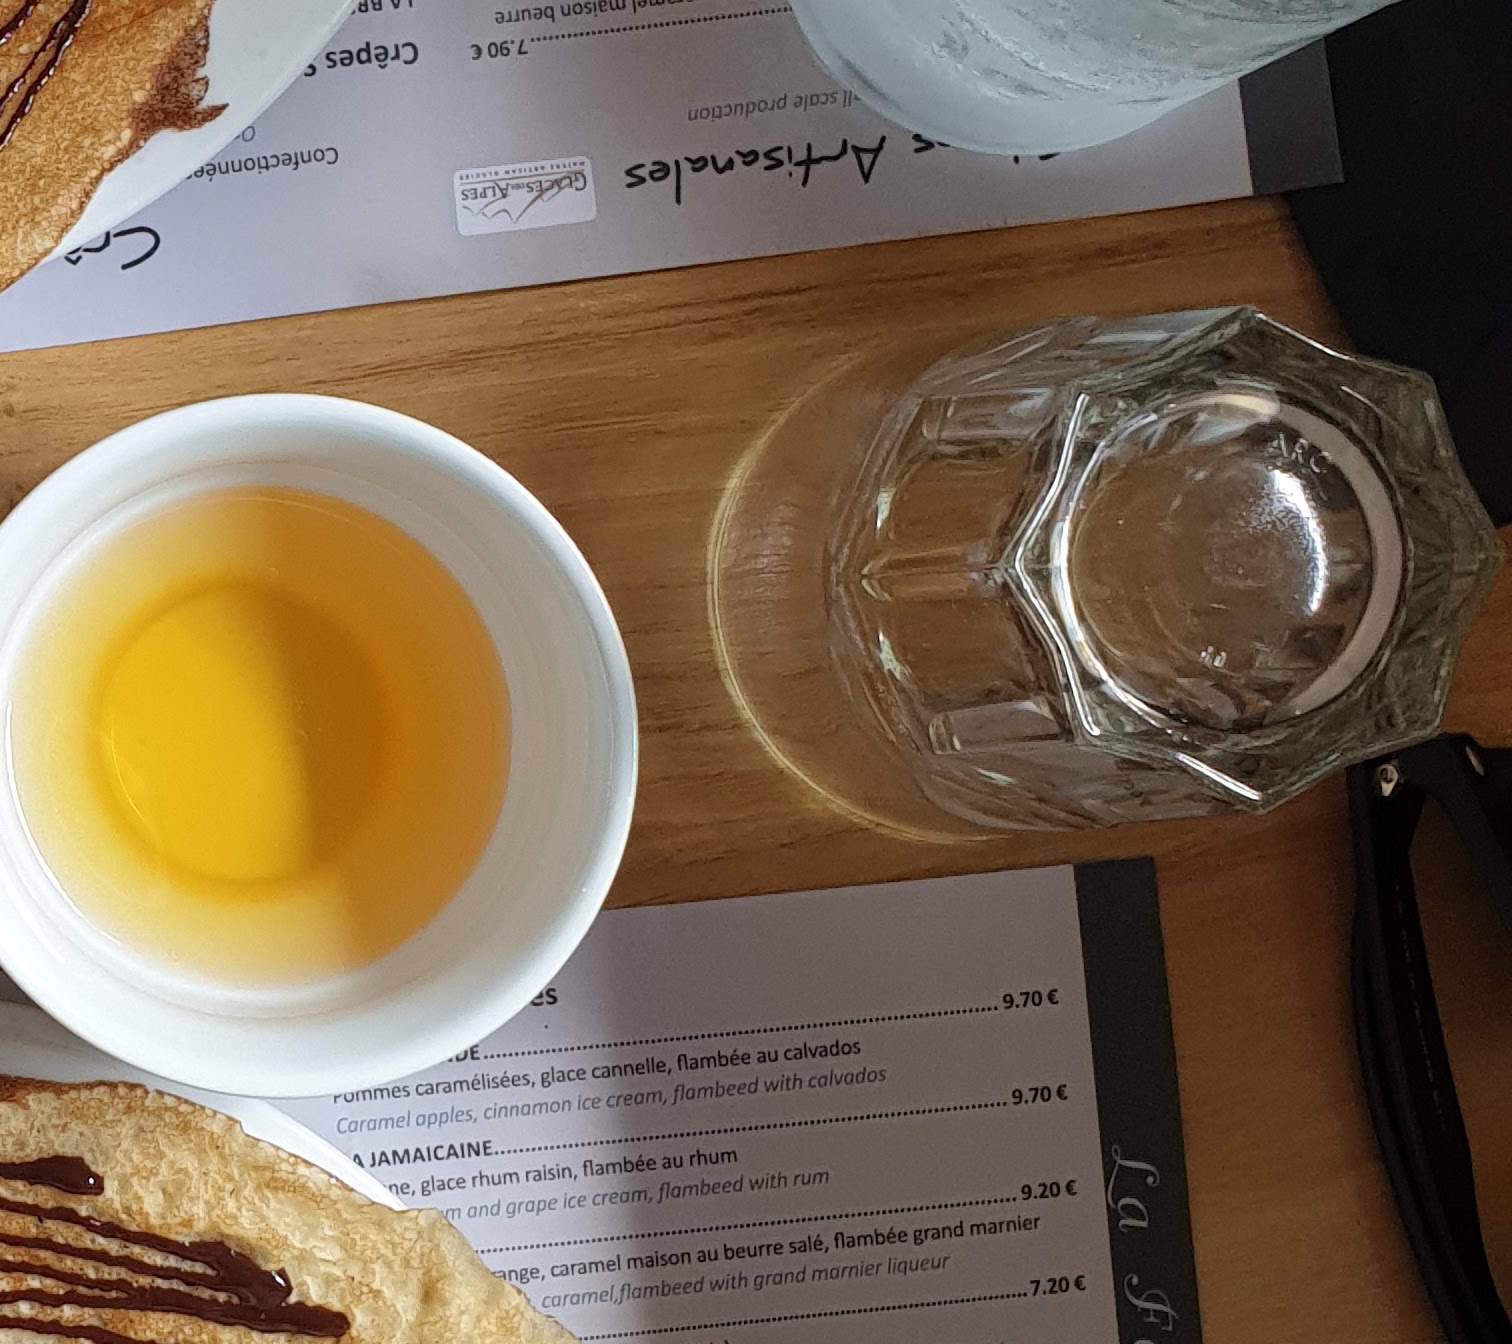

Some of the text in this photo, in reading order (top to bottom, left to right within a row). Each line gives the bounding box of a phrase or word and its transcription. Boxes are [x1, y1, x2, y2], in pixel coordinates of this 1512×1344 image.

[494, 5, 556, 25] beurre
[325, 41, 419, 70] Crêpes
[470, 38, 528, 61] 7.90 €
[687, 89, 839, 123] scale production
[186, 147, 339, 183] Confectionnée
[624, 135, 887, 203] Artisanales
[461, 181, 510, 202] ALPES
[1002, 988, 1060, 1010] 9.70 €
[415, 1039, 861, 1097] caramélisées, glace cannelle, flambée au calvados
[1011, 1083, 1069, 1107] 9.70 €
[369, 1139, 493, 1168] JAMAICAINE
[1107, 1145, 1160, 1232] La
[1029, 1274, 1087, 1297] 7.20 €
